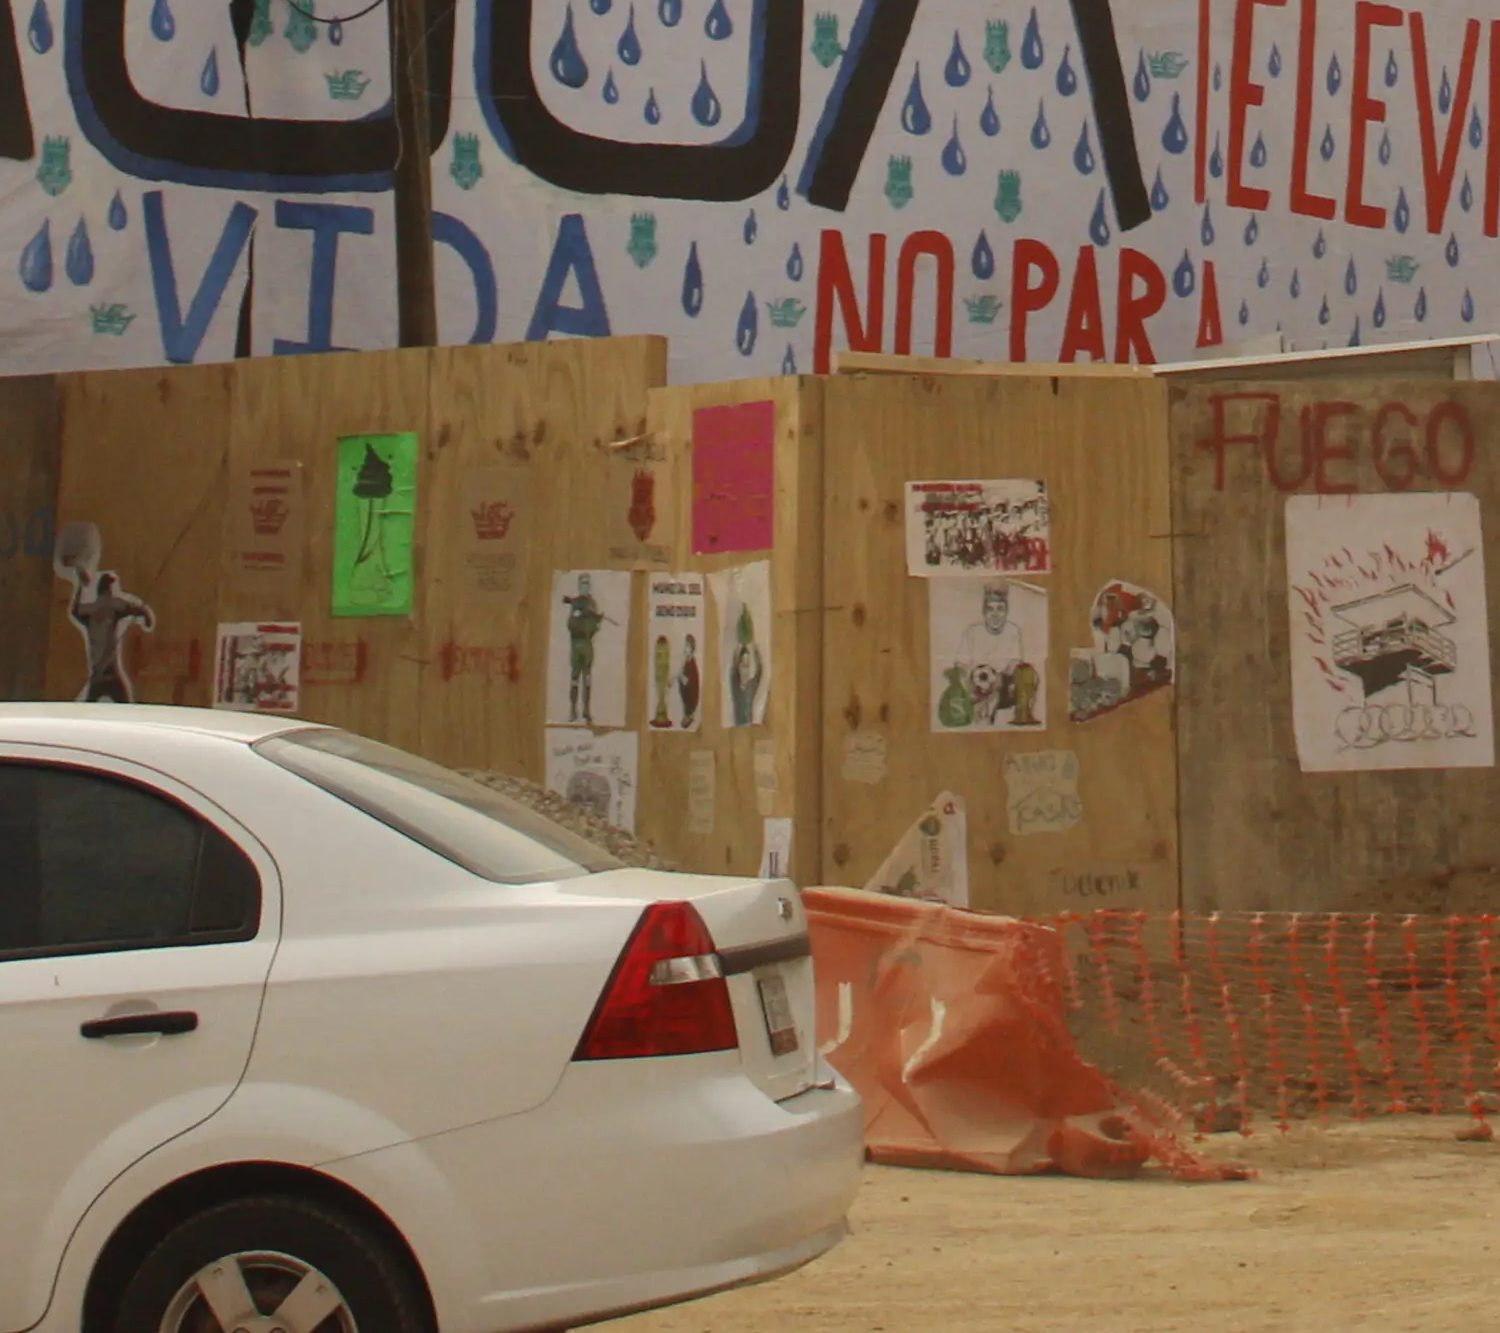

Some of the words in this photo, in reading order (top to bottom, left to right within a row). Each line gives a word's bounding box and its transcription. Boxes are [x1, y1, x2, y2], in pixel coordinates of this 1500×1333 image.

[142, 189, 614, 365] VIDA
[812, 229, 955, 374] NO
[1009, 238, 1224, 366] PARA
[1197, 393, 1476, 493] FUEGO
